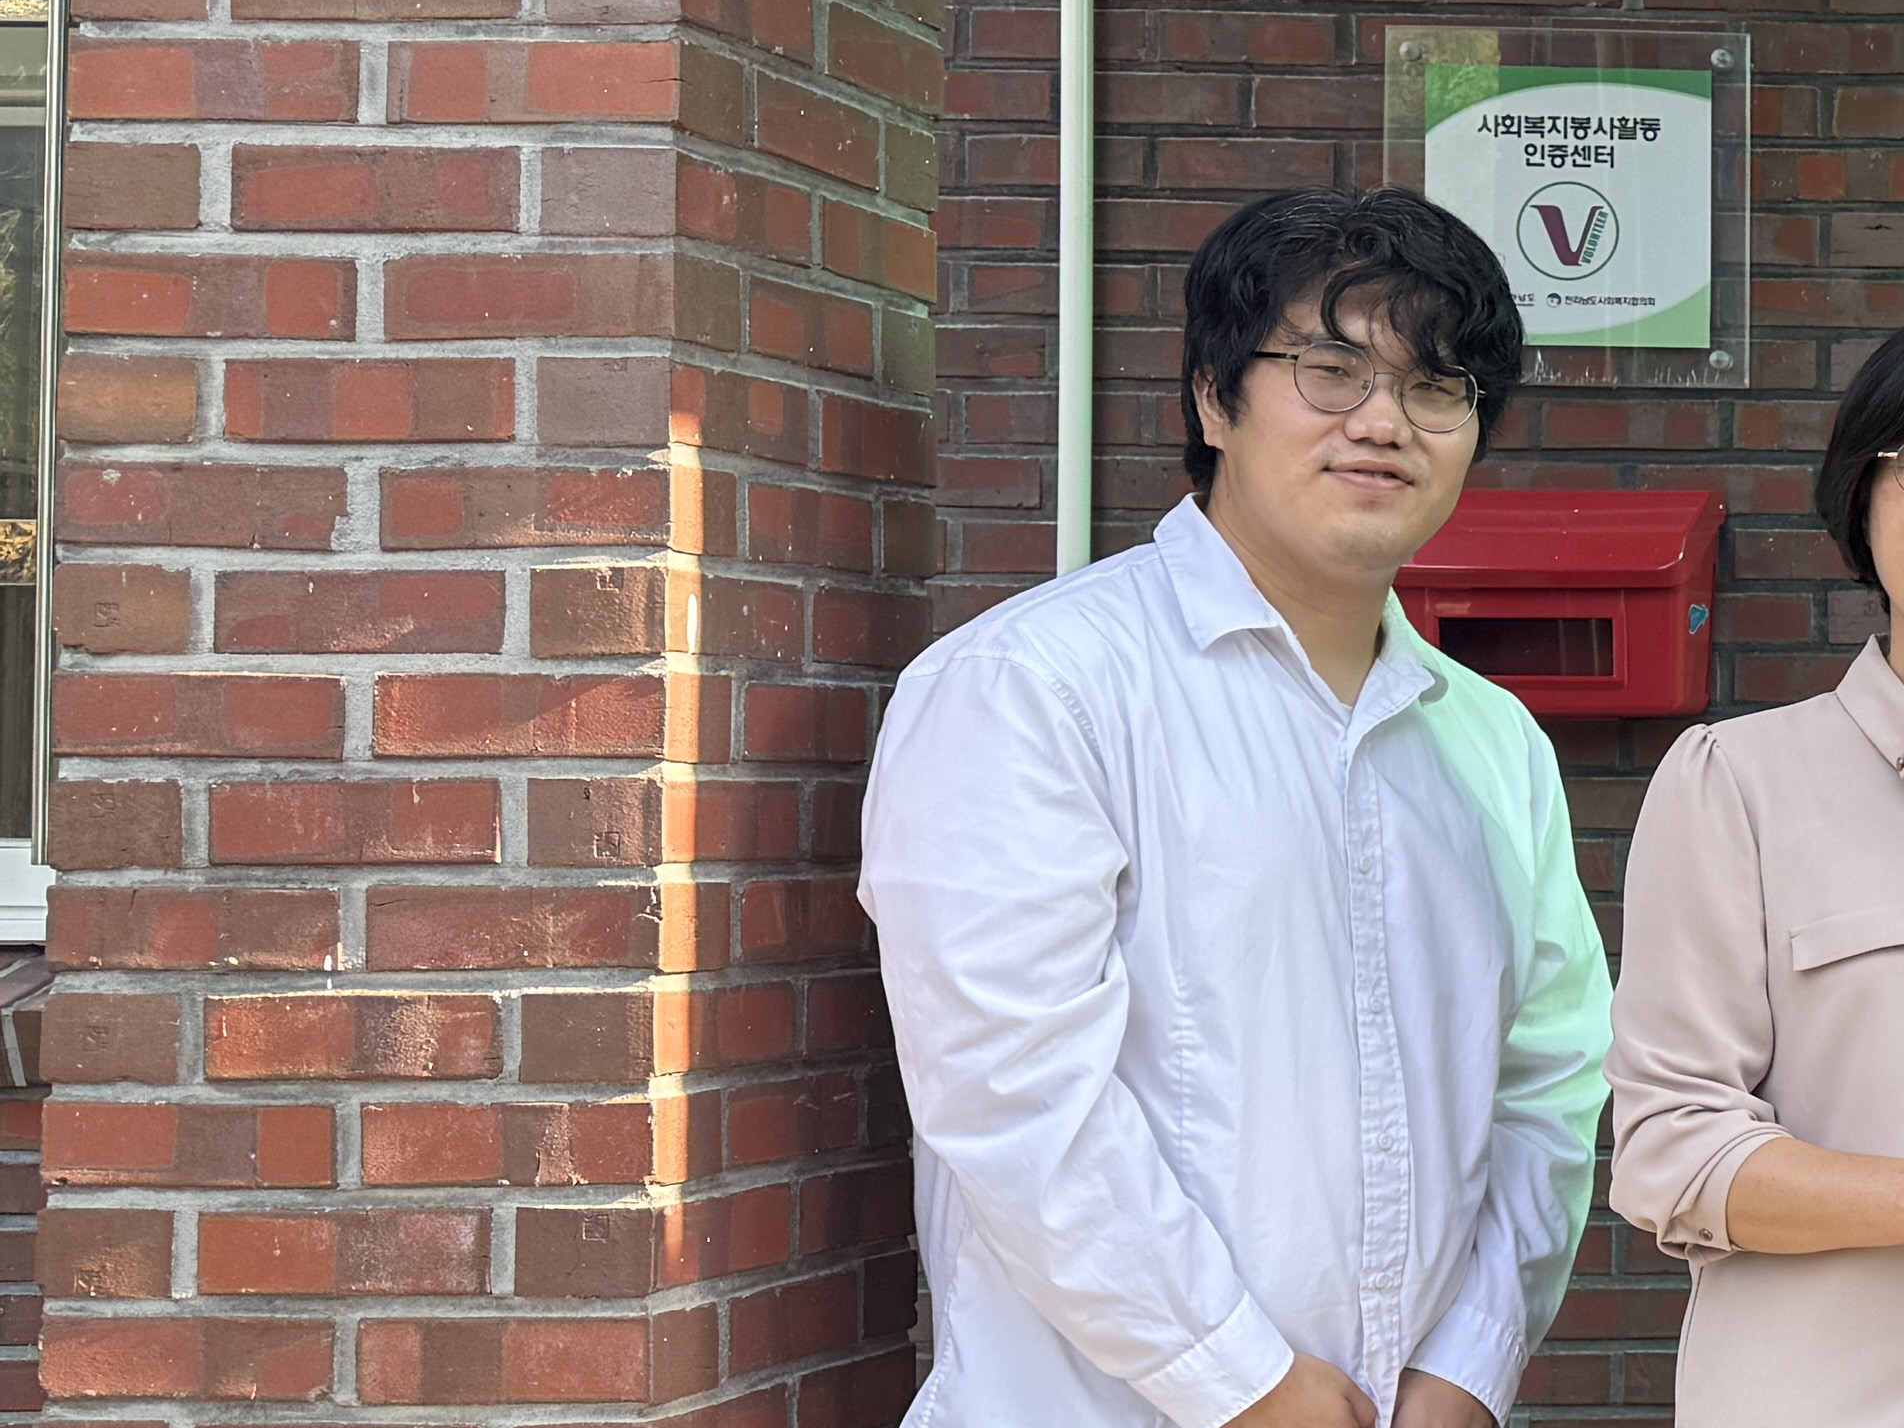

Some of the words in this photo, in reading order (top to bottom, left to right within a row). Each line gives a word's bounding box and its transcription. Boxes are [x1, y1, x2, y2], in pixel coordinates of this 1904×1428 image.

[1477, 114, 1661, 140] 사회복지봉사활동
[1524, 143, 1615, 168] 인증센터
[1581, 210, 1609, 264] VOLUNTEER
